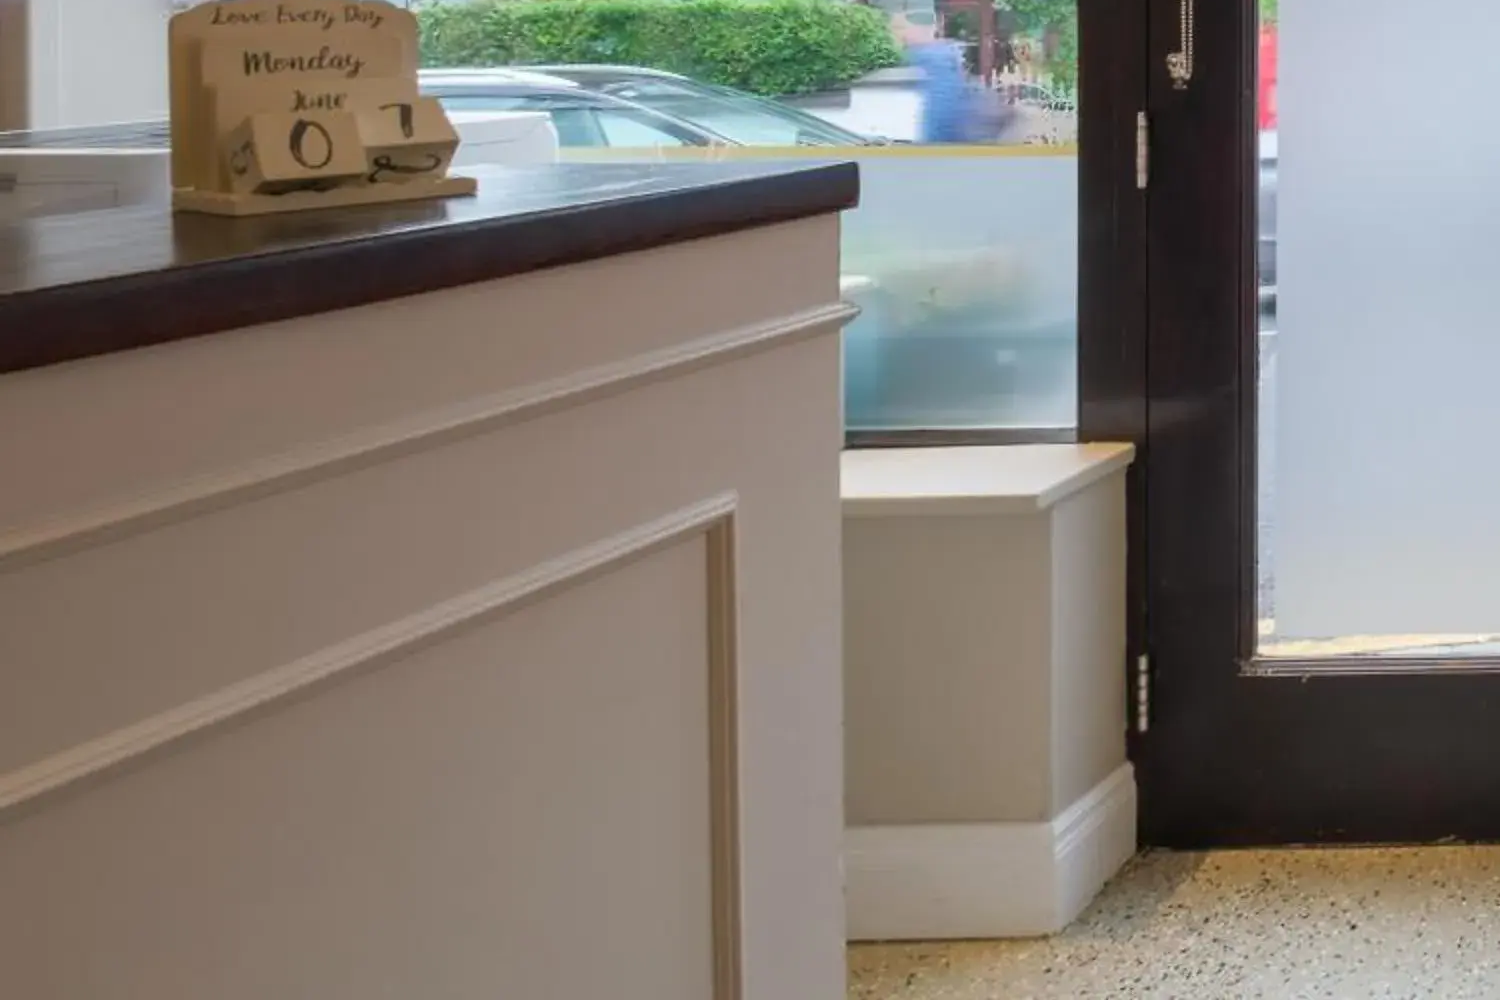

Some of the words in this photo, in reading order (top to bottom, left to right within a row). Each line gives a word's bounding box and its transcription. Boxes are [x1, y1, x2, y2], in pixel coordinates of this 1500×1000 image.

[210, 5, 268, 26] Love
[276, 3, 336, 30] Every
[343, 3, 384, 29] Day
[243, 46, 365, 78] Monday
[290, 88, 348, 113] June
